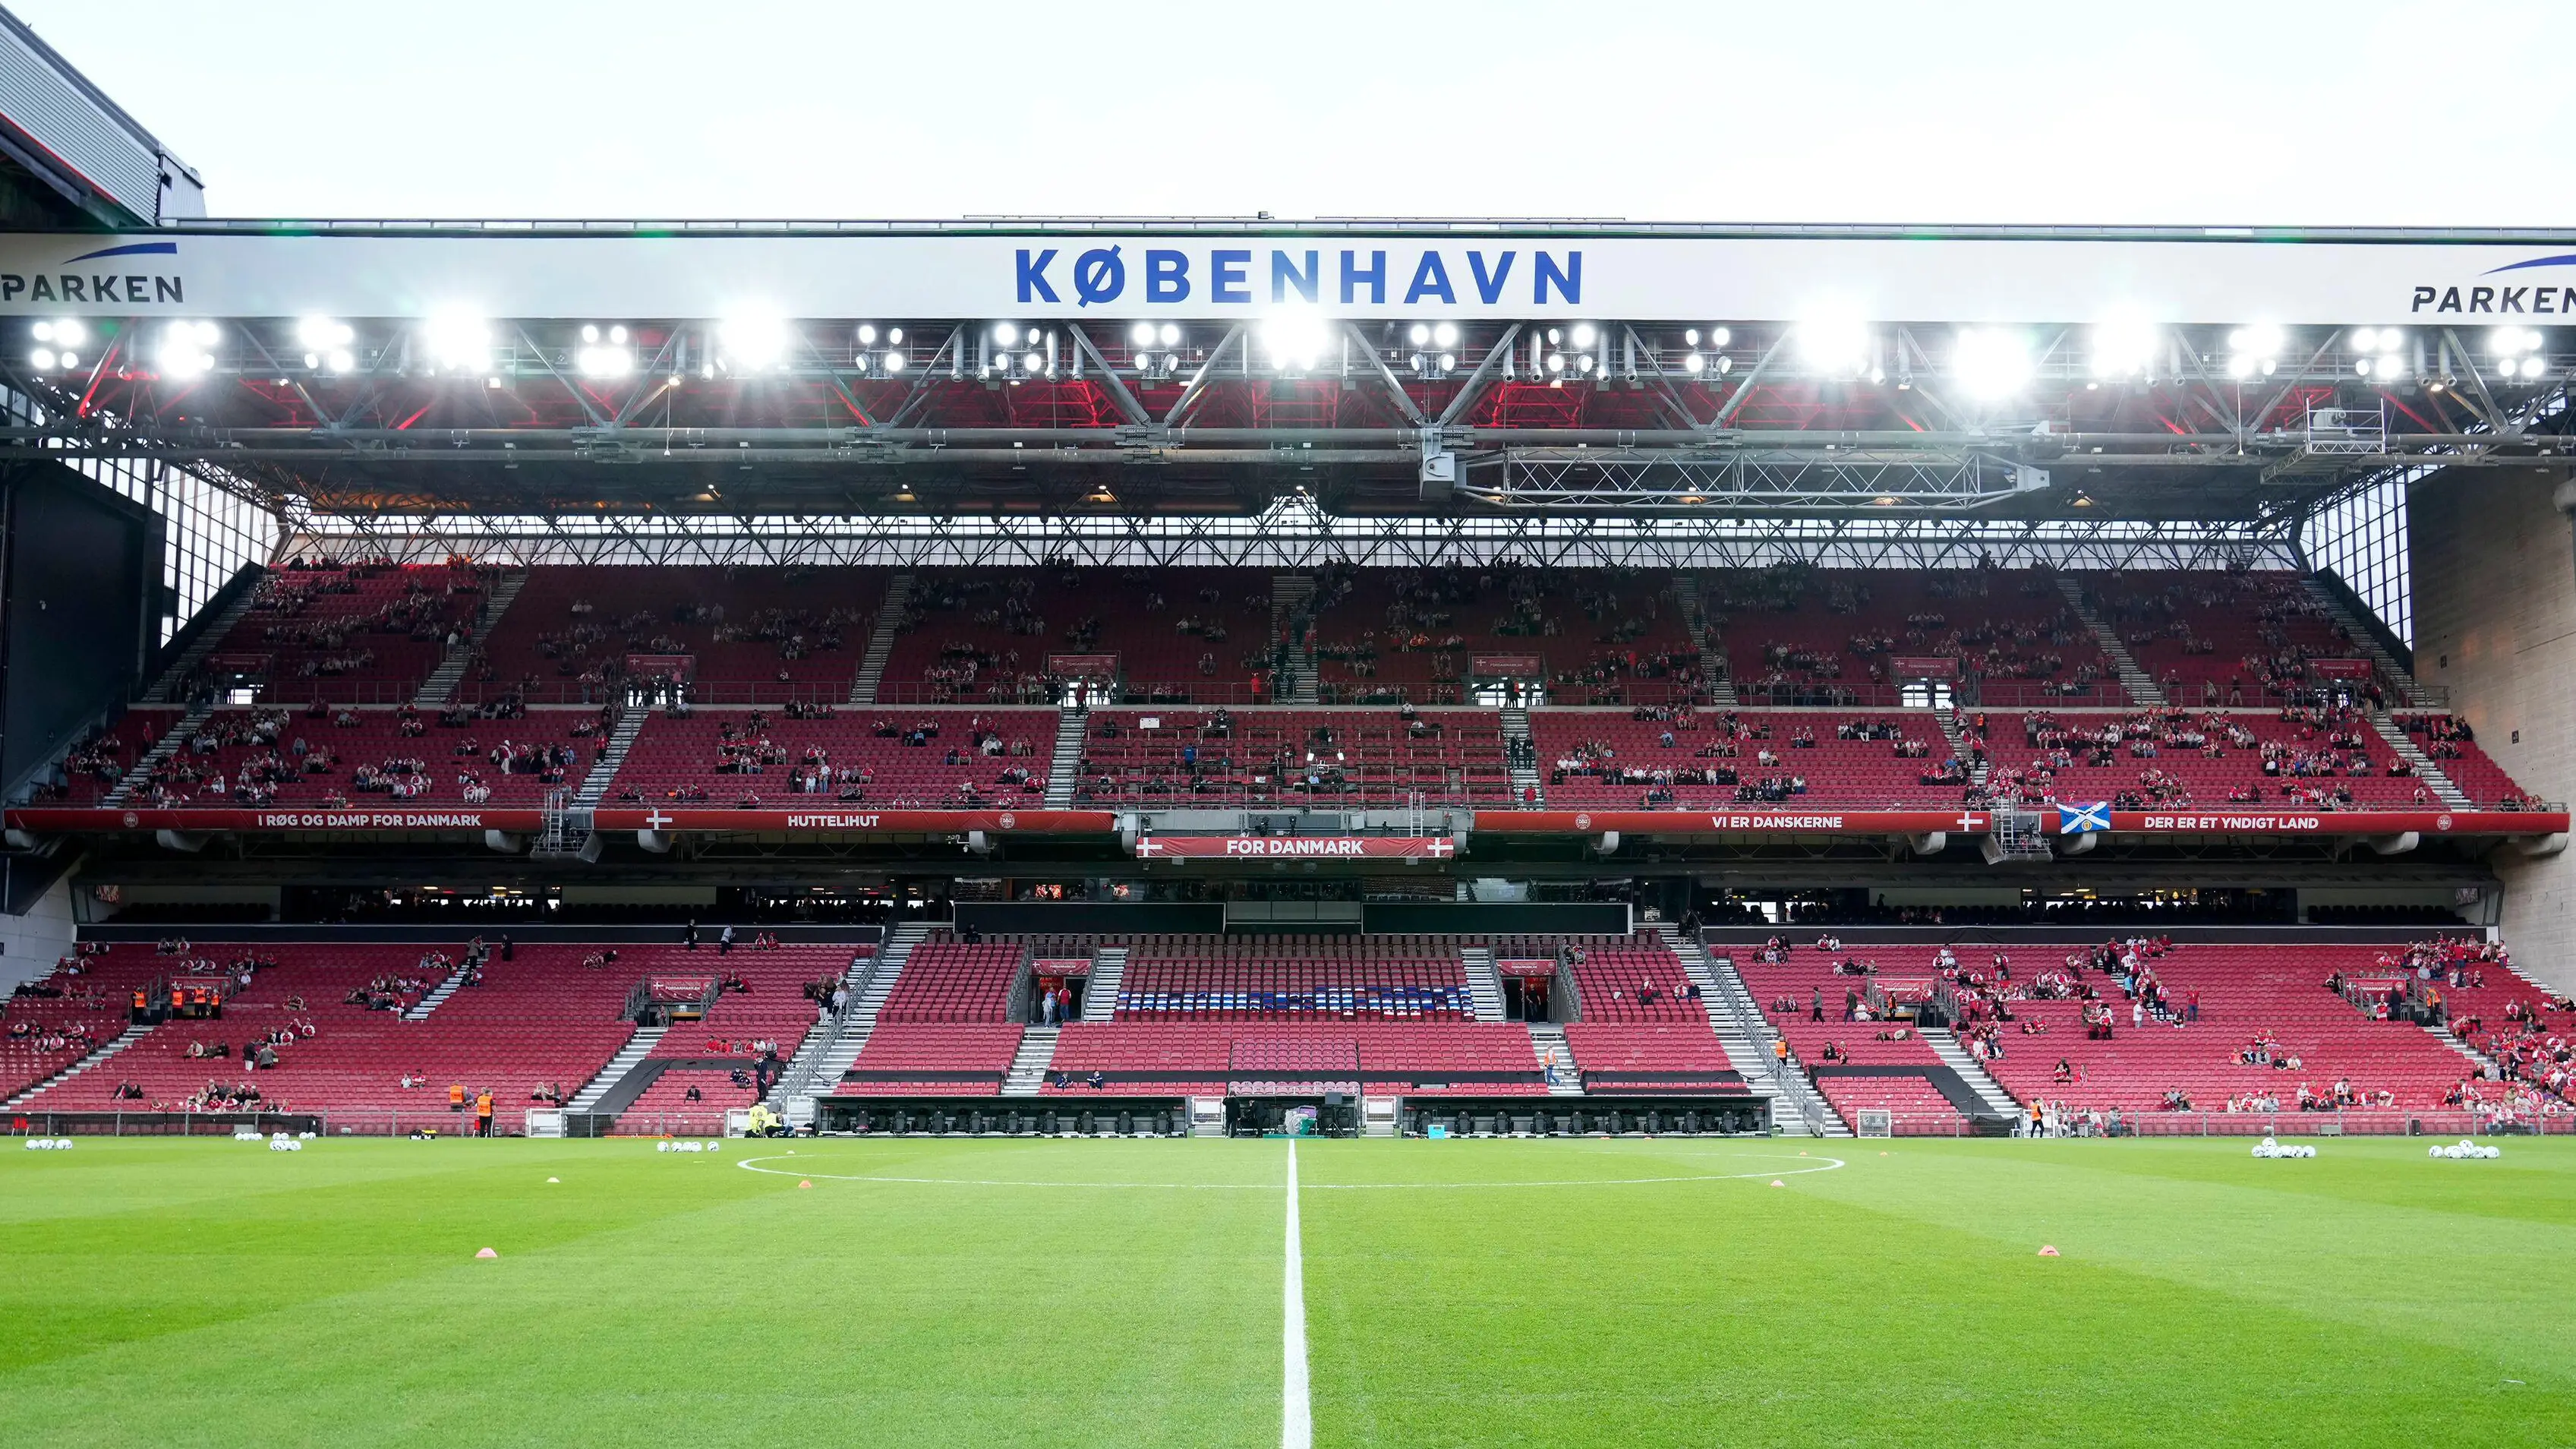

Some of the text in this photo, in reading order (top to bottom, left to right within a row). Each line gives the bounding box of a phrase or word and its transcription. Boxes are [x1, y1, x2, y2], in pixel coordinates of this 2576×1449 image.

[1015, 245, 1582, 308] KØBENHAVN
[0, 274, 184, 303] PARKEN
[257, 814, 482, 826] I RØG OG DAMP FOR DANMARK
[787, 815, 880, 827] HUTTELIHUT
[1711, 816, 1843, 828] VI ER DANSKERNE
[2144, 817, 2319, 829] DER ER ET YNDIGT LAND
[1226, 840, 1364, 854] FOR DANMARK
